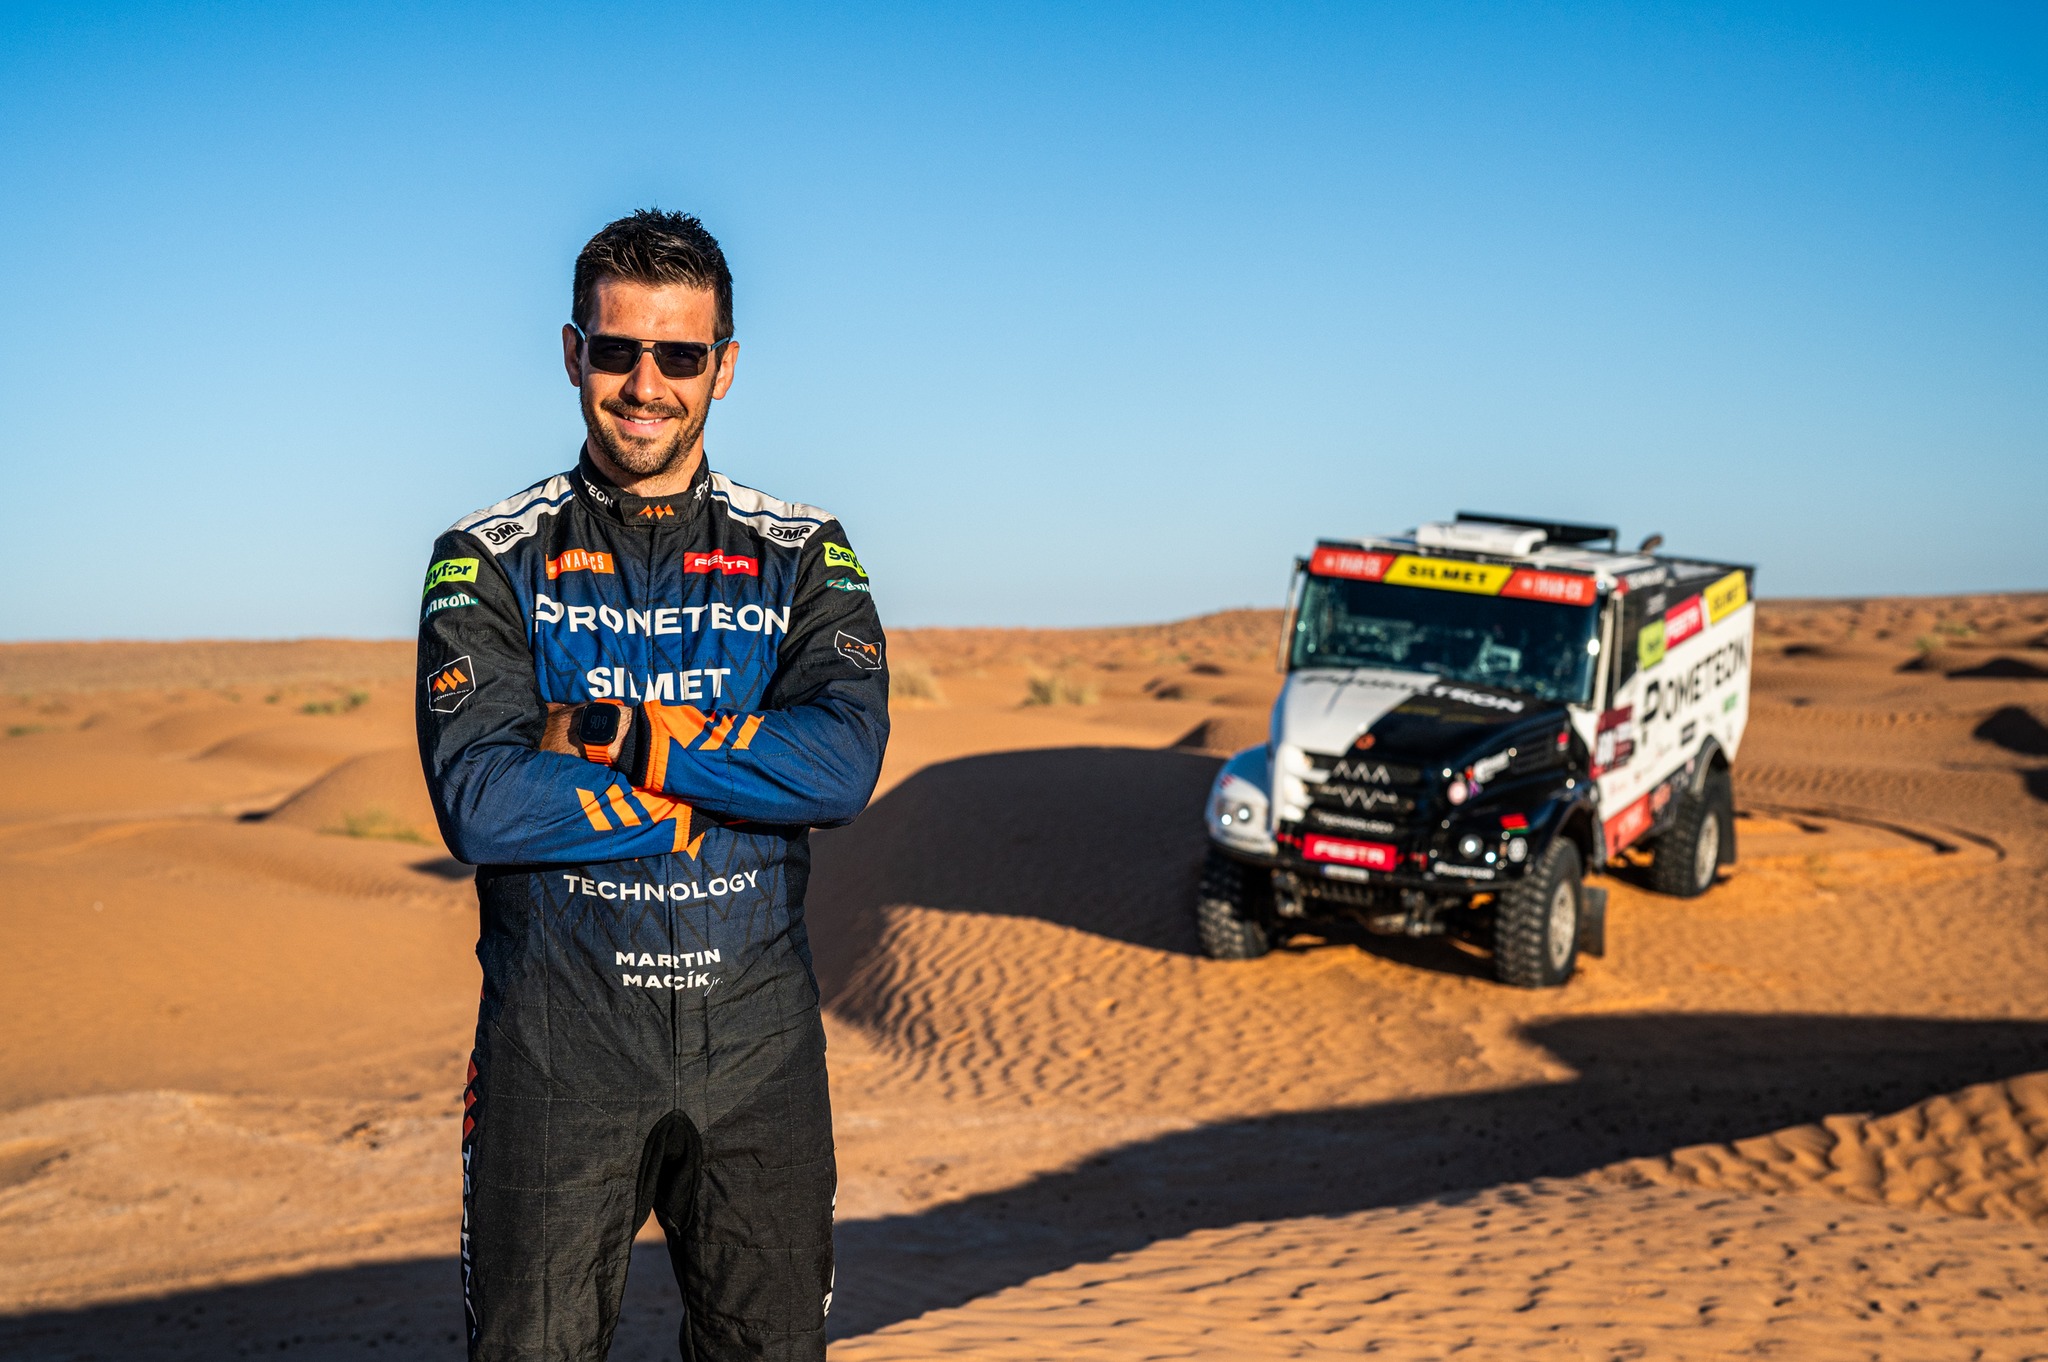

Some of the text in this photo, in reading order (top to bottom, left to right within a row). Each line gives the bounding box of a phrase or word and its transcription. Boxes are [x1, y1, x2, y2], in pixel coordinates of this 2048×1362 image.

[485, 524, 524, 542] OMP
[769, 527, 811, 540] OMP
[694, 554, 750, 570] FESTA
[1407, 564, 1489, 586] SILMET
[586, 666, 731, 703] SILMET
[1312, 840, 1387, 866] FESTA
[562, 869, 759, 903] TECHNOLOGY
[615, 948, 721, 969] MARTIN
[622, 970, 711, 991] MACÍK
